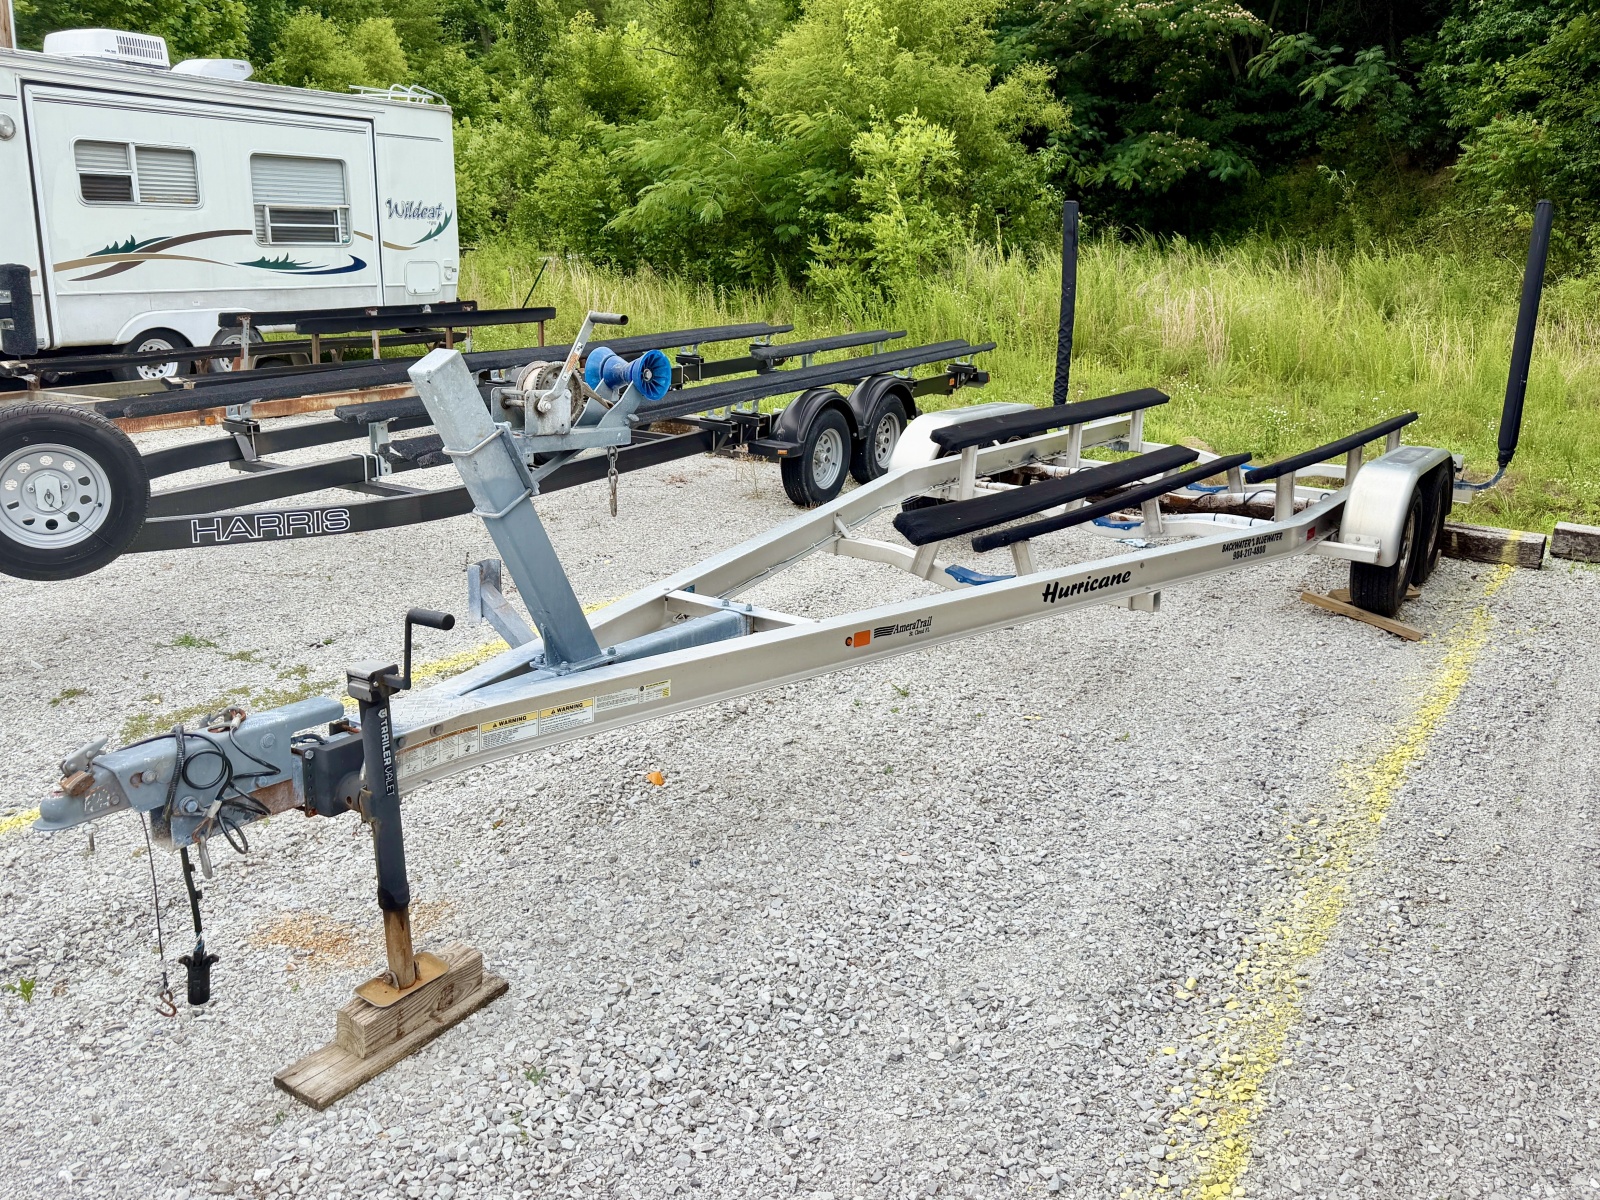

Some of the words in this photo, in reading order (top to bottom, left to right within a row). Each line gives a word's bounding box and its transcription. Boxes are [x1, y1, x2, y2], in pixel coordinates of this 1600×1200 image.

[385, 198, 444, 220] Wildcat
[190, 508, 350, 543] HARRIS
[1042, 571, 1131, 603] Hurricane
[893, 616, 932, 634] AmeraTrail
[498, 715, 527, 726] WARNING
[556, 702, 583, 713] WARNING
[380, 719, 392, 766] TRAILER
[384, 766, 396, 796] VALET
